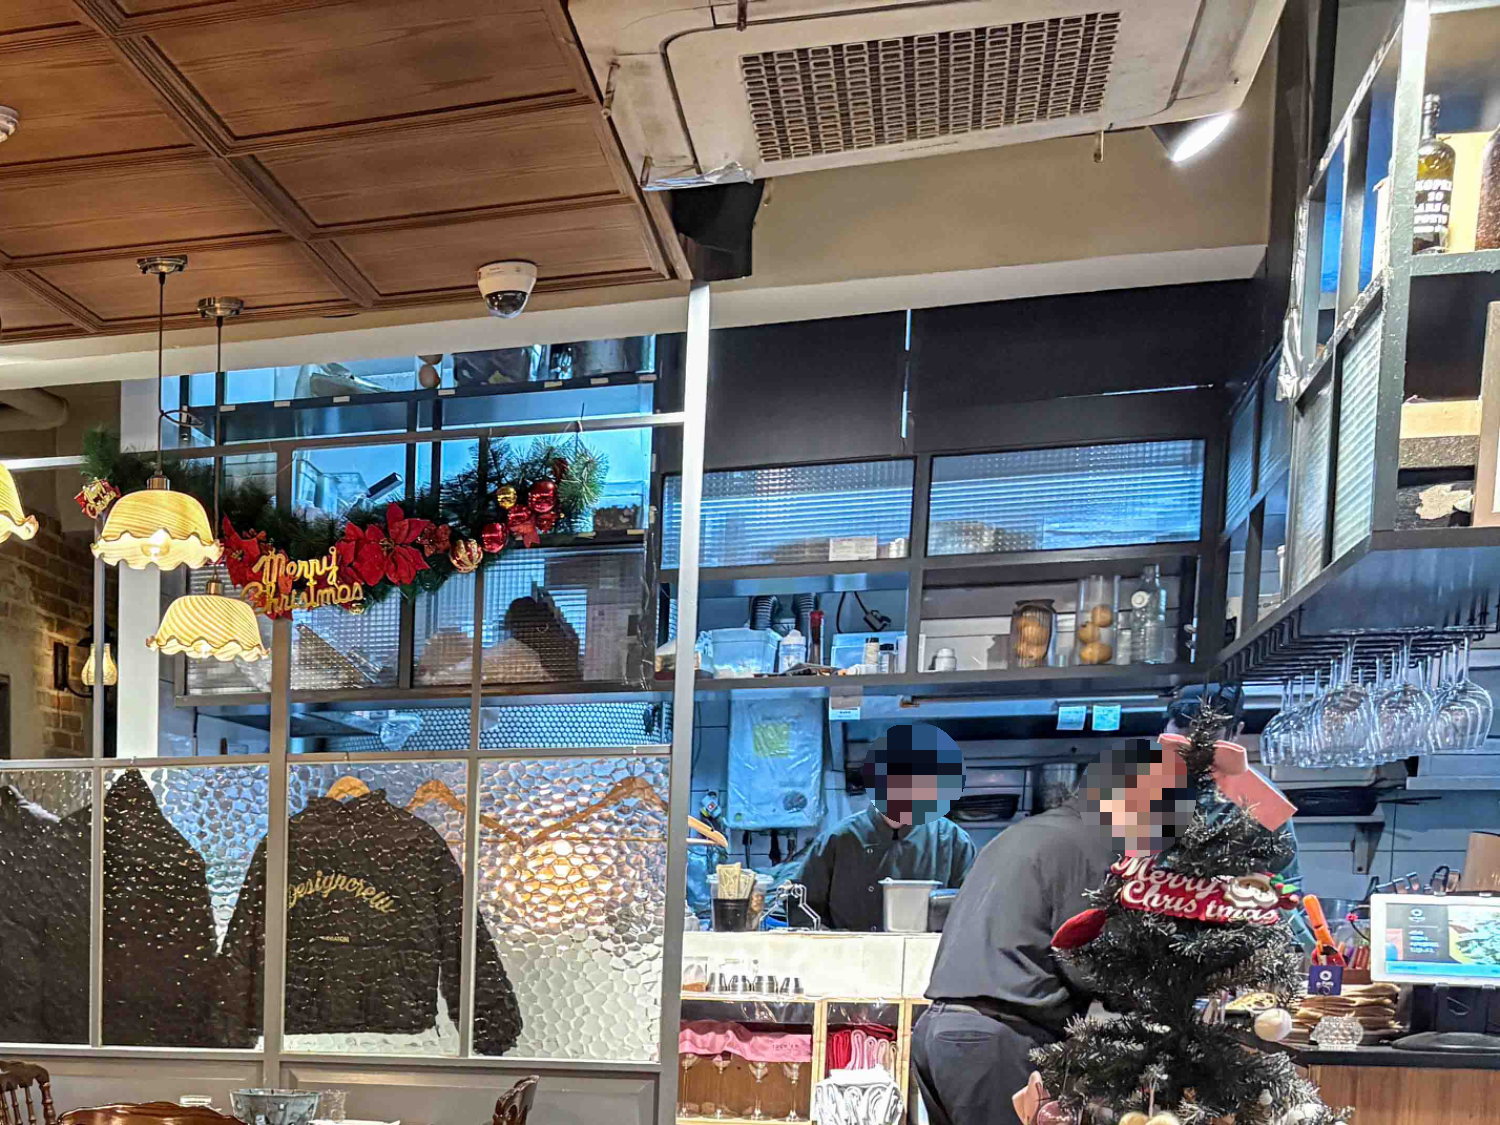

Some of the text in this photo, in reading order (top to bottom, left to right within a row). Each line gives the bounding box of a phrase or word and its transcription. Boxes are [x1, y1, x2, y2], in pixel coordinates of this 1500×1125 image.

[251, 546, 339, 586] Merry
[241, 581, 364, 615] Christmas
[1110, 855, 1220, 899] Merry
